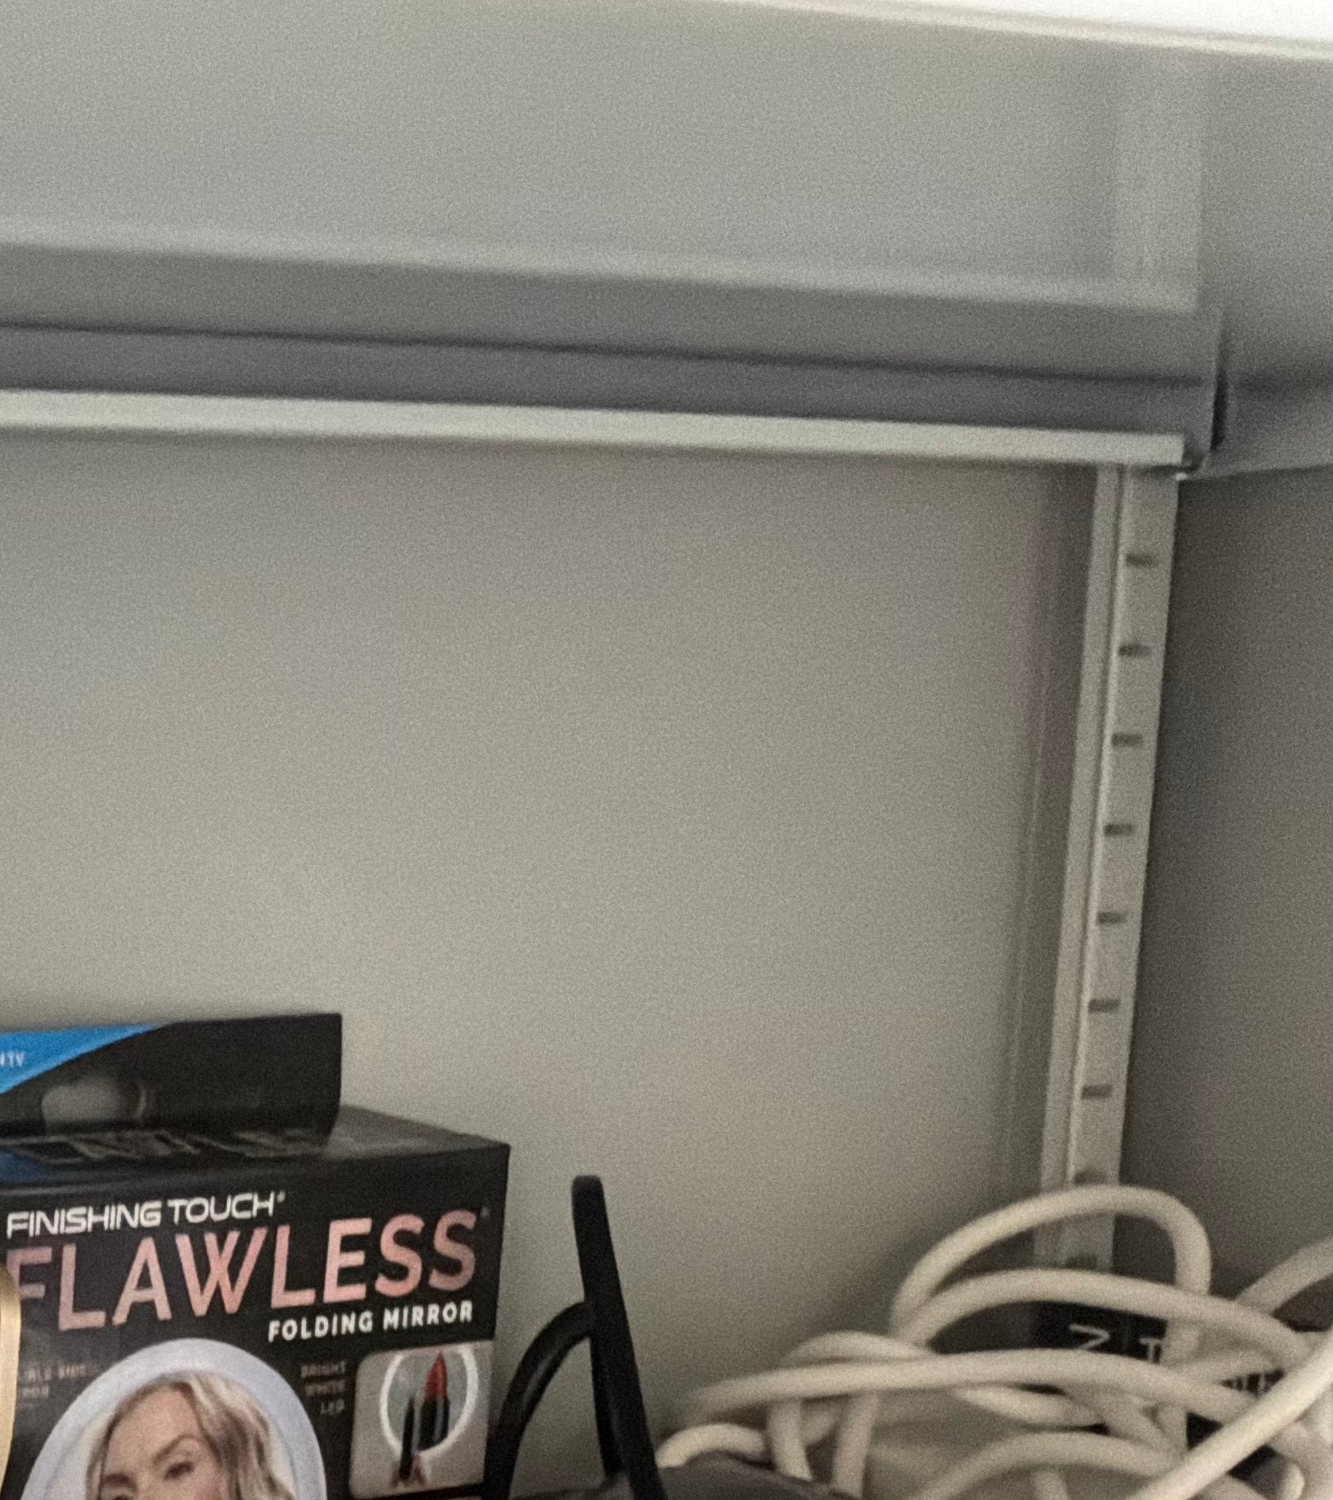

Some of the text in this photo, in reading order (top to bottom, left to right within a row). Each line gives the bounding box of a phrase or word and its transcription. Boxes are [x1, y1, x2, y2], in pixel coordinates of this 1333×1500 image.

[6, 1192, 277, 1239] FINISHING TOUCH
[5, 1208, 478, 1333] FLAWLESS
[268, 1300, 474, 1343] FOLDING MIRROR
